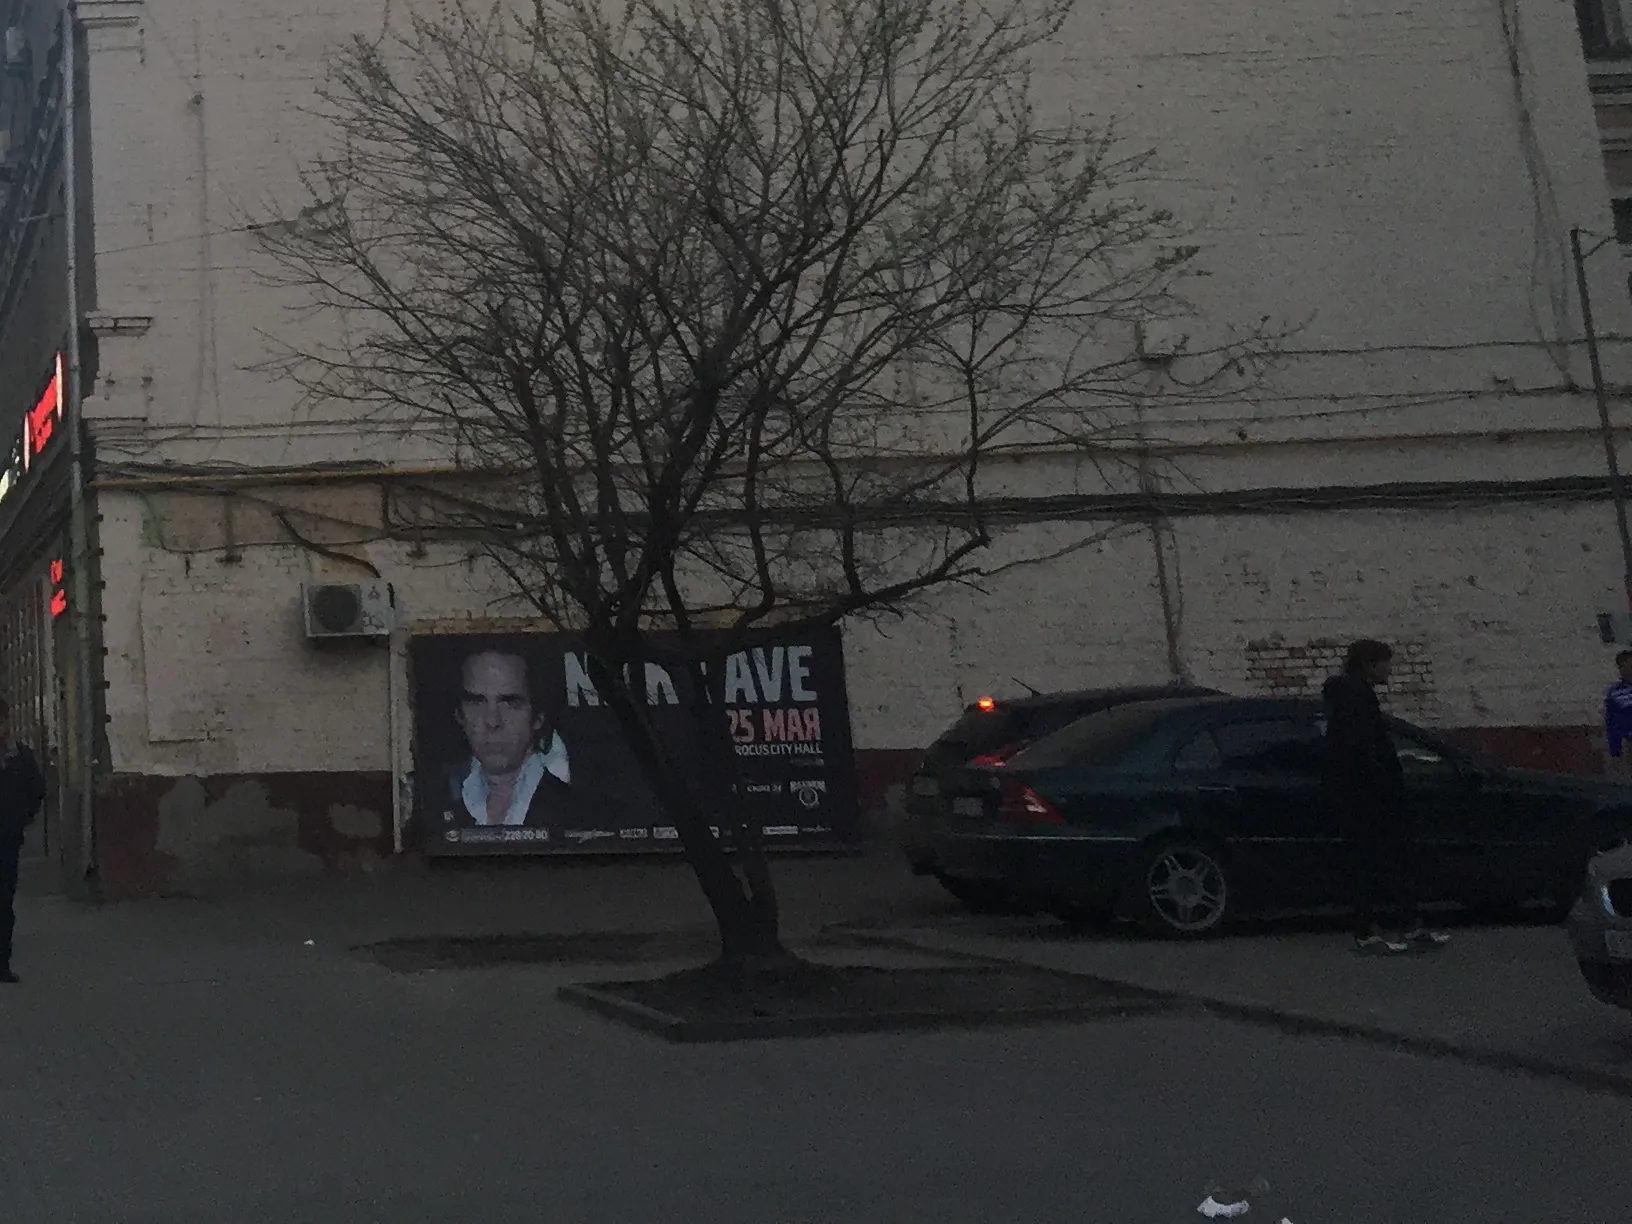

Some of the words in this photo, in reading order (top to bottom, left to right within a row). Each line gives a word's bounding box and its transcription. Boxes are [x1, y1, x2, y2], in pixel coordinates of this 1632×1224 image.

[699, 645, 818, 707] AVE
[725, 709, 755, 743] 25
[762, 707, 822, 742] МАЯ
[733, 745, 769, 757] ROCUS
[770, 744, 792, 755] CITY
[794, 742, 823, 755] HALL
